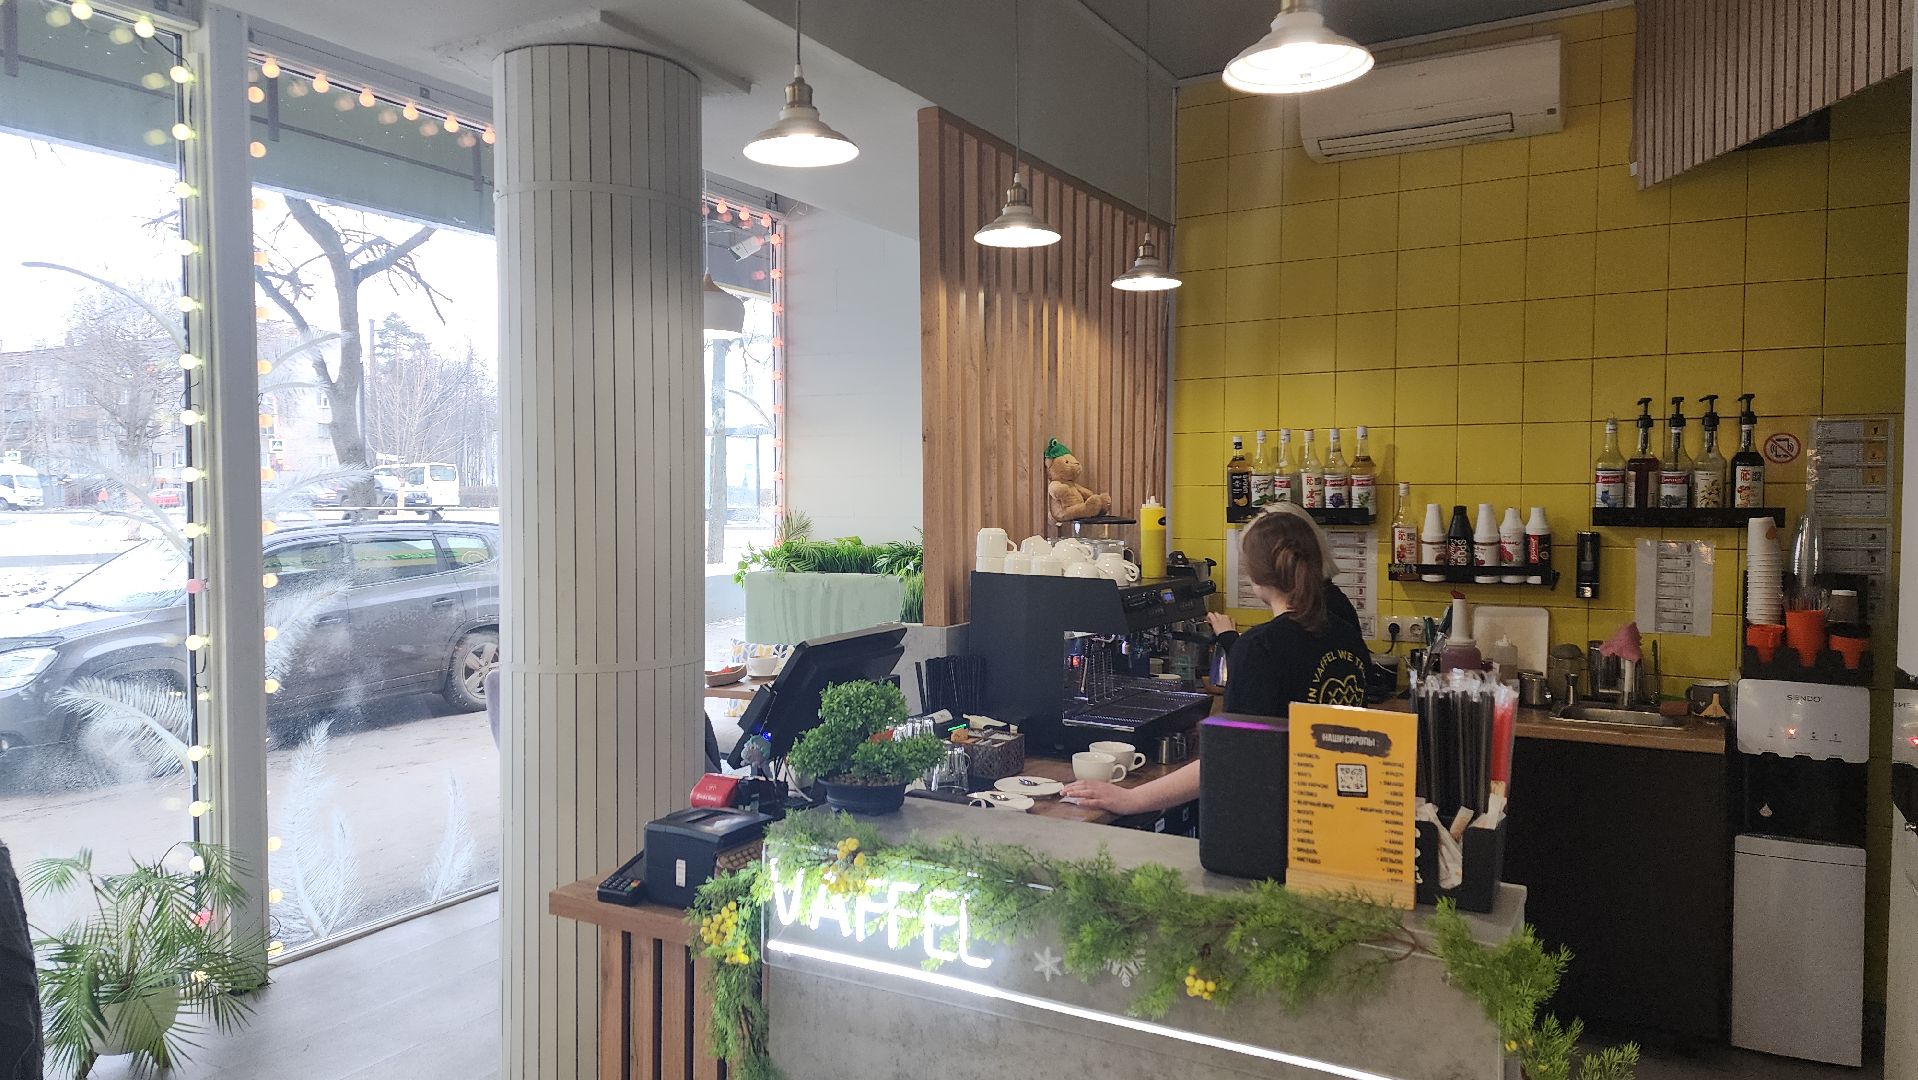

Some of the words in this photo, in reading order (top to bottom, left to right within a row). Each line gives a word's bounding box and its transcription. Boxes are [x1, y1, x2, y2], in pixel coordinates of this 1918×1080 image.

[1312, 651, 1338, 683] VAFFEL
[1337, 649, 1354, 662] WE
[1321, 733, 1345, 743] НАШИ
[770, 857, 992, 969] VAFFEL
